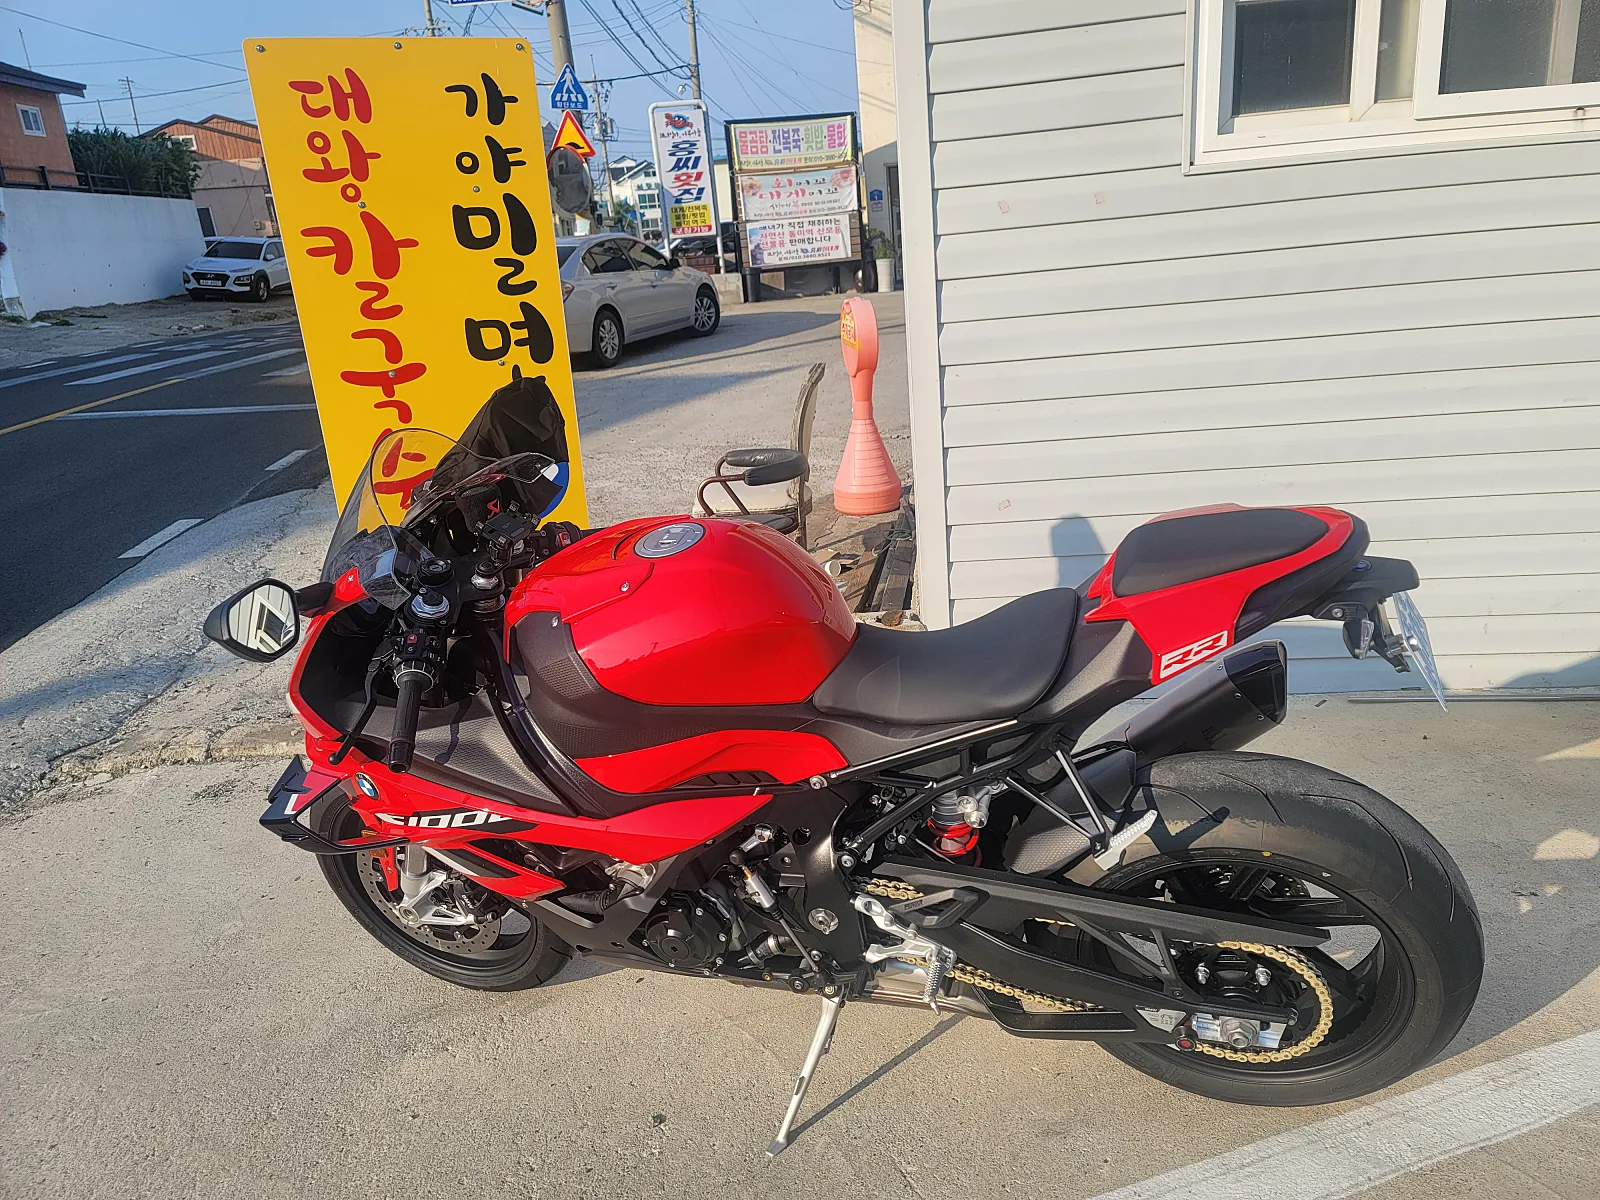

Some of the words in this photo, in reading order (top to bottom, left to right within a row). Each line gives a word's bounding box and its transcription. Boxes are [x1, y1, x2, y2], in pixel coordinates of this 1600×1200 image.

[444, 72, 555, 383] 가야밀면
[788, 221, 804, 229] 직접
[807, 218, 840, 227] 채취하는
[760, 231, 785, 239] 자연산
[789, 236, 831, 246] 판매합니다
